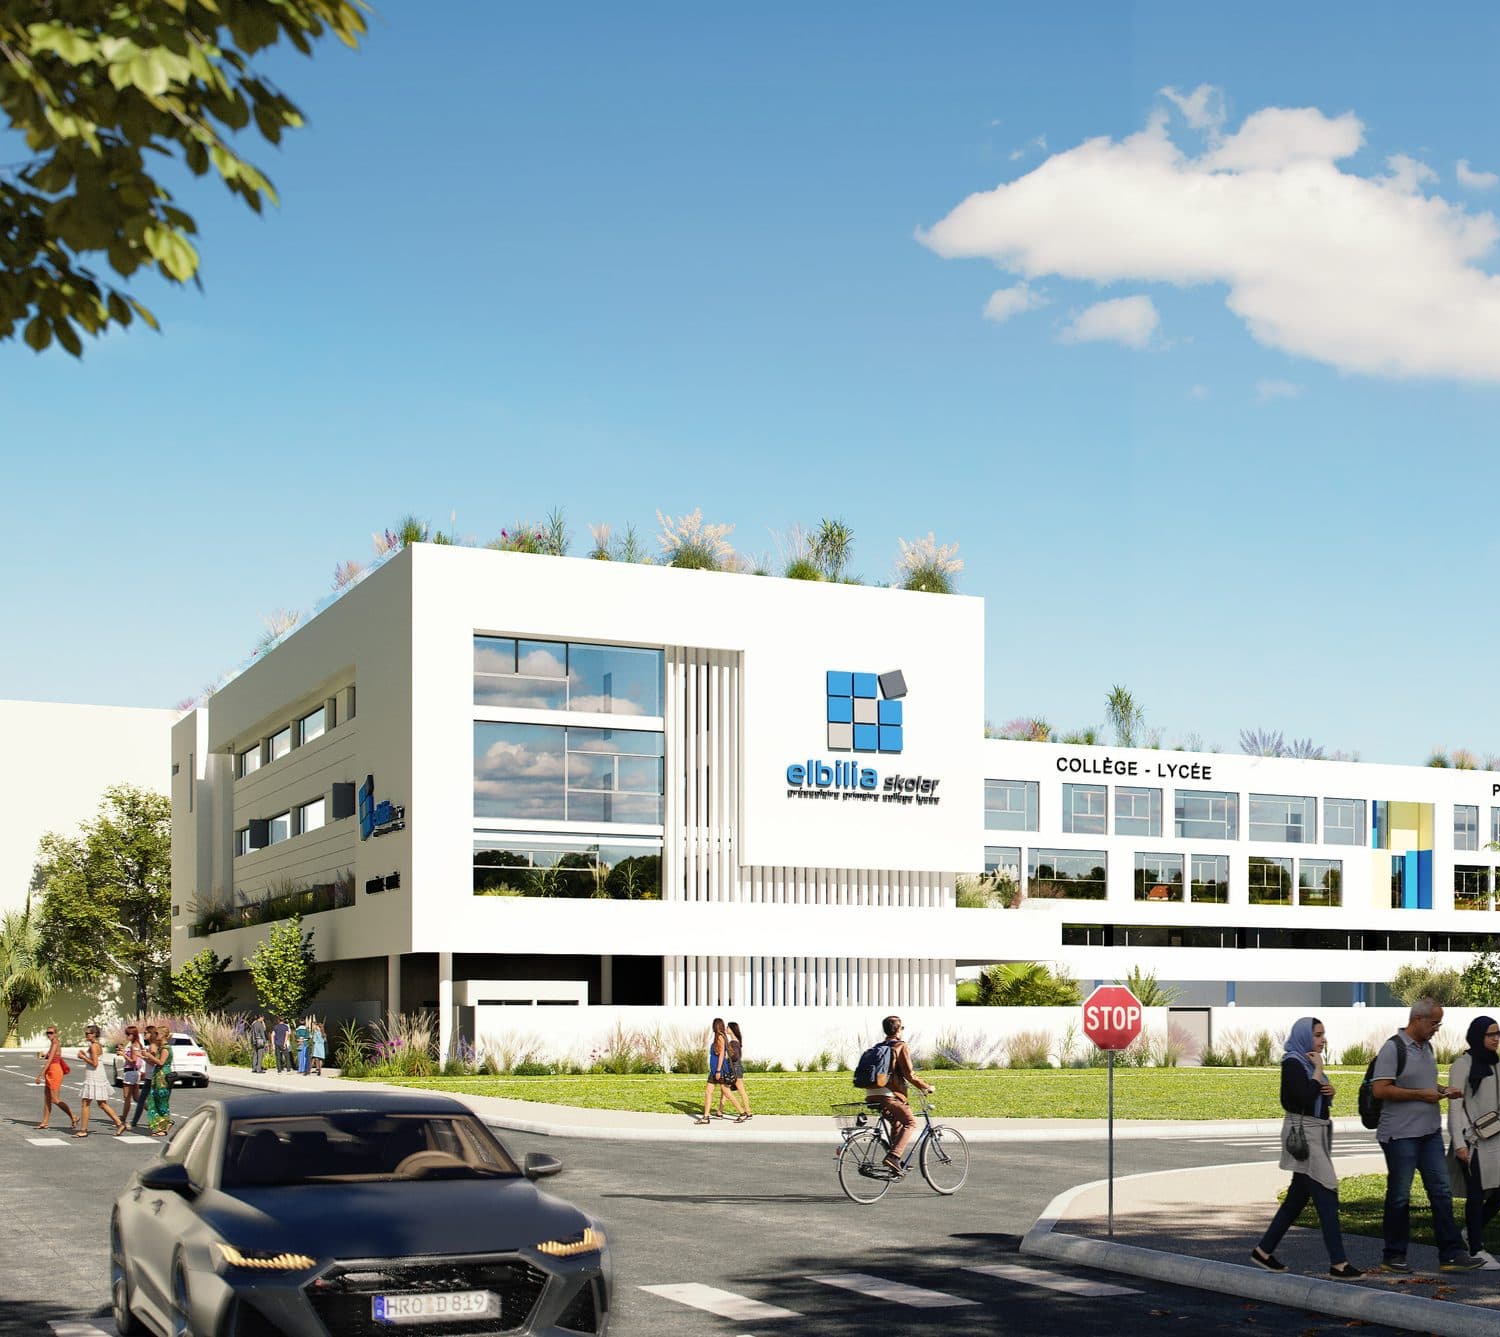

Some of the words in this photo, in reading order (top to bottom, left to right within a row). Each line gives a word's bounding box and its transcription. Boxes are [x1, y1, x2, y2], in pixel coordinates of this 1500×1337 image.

[786, 759, 878, 790] elbilia
[883, 774, 940, 796] skolar
[1056, 757, 1138, 776] COLLÈGE
[1158, 762, 1212, 780] LYCÉE
[1086, 1005, 1140, 1031] STOP
[452, 1294, 484, 1311] 819
